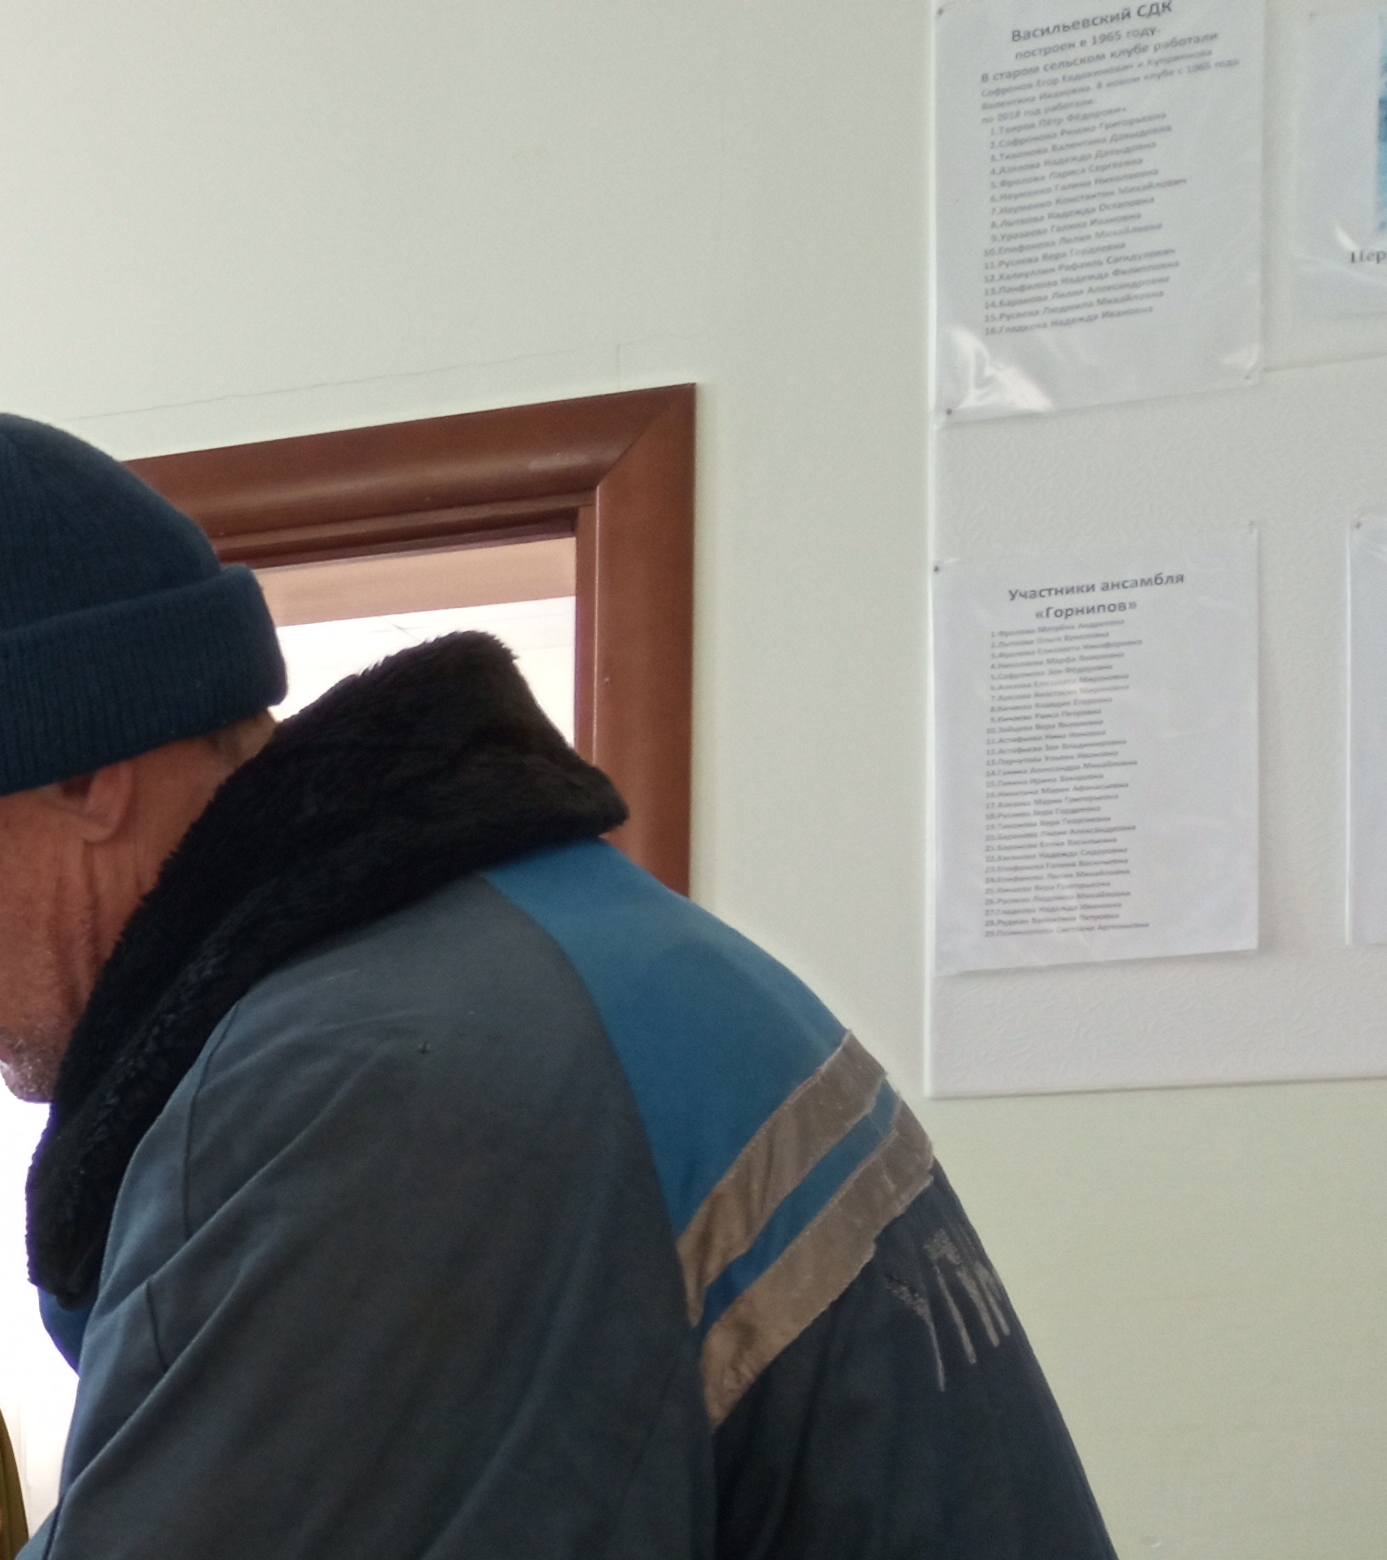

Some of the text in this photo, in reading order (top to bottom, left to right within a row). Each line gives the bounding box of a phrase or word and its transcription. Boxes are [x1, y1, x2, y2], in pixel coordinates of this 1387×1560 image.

[1012, 1, 1173, 42] Васильевский СДК
[981, 32, 1218, 83] В старом сельском клубе работали
[1015, 40, 1076, 60] построен
[1091, 31, 1122, 45] 1965
[1009, 572, 1185, 601] Участники ансамбля
[1035, 601, 1137, 620] «Горнипов»
